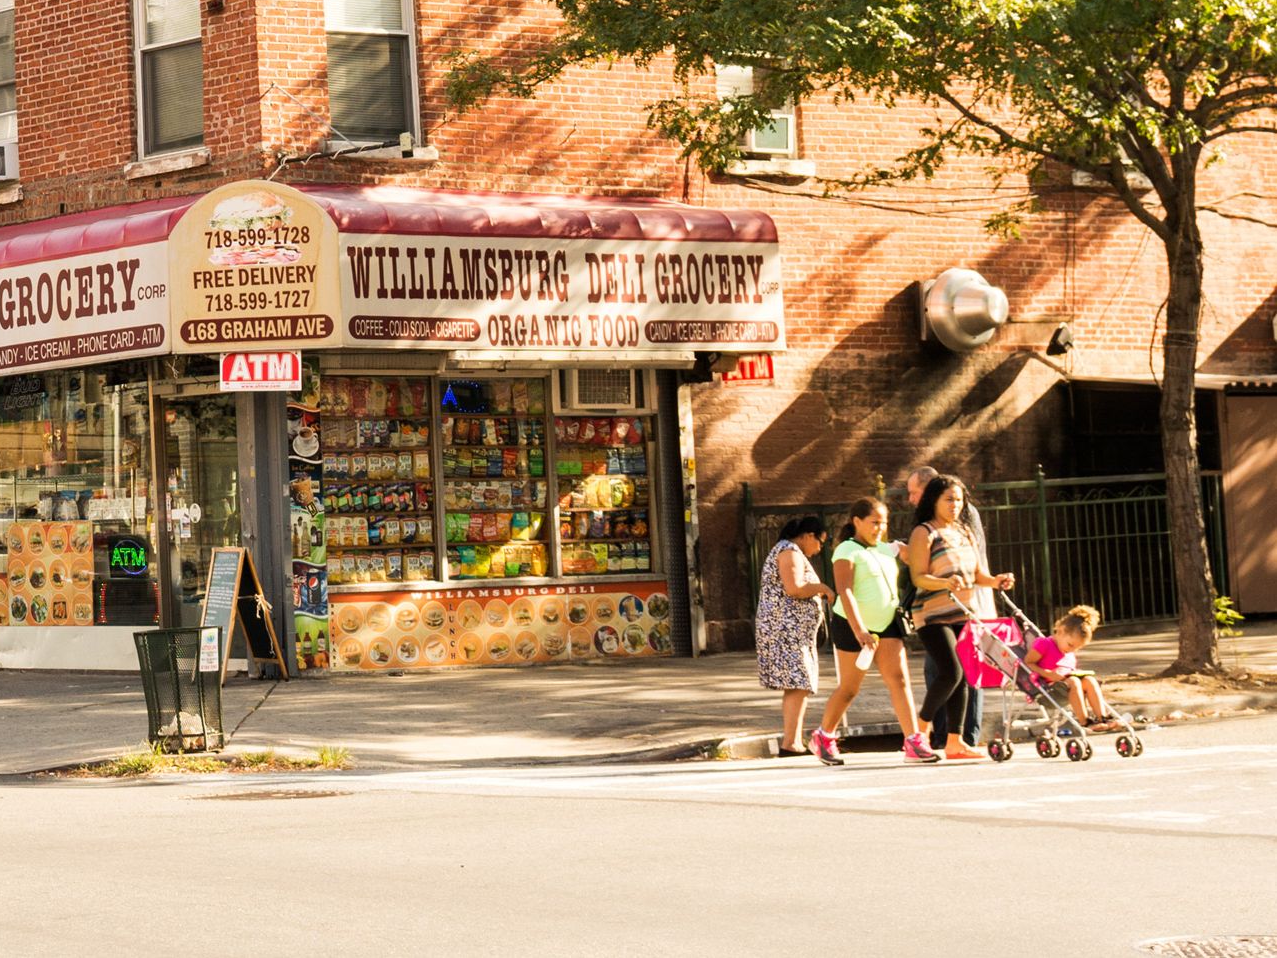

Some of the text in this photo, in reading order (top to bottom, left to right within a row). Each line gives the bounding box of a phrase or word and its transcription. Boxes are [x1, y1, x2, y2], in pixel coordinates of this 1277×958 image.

[204, 226, 310, 249] 718-599-1728
[193, 264, 317, 289] FREE DELIVERY
[347, 246, 570, 302] WILLIAMSBURG
[585, 253, 647, 304] DELI
[655, 252, 763, 304] GROCERY
[205, 290, 310, 312] 718-599-1727
[188, 317, 326, 341] 168 GRAHAM AVE
[354, 319, 384, 336] COFFEE
[389, 320, 409, 337] COLD
[410, 321, 431, 337] SODA
[435, 321, 475, 338] CIGARETTE
[487, 315, 640, 347] ORGANIC FOOD
[649, 323, 673, 340] CANDY
[688, 323, 712, 341] CREAM
[716, 323, 739, 341] PHONE
[740, 323, 758, 341] CARD
[761, 323, 774, 341] ATM
[25, 347, 39, 362] ICE
[40, 341, 71, 360] CREAM
[77, 336, 108, 354] PHONE
[110, 332, 135, 350] CARD
[142, 327, 161, 344] ATM
[229, 353, 293, 381] ATM
[727, 353, 770, 379] ATM
[111, 547, 147, 567] ATM
[410, 585, 596, 600] WILLIAMSBURG DELI
[448, 604, 456, 660] LUNCH
